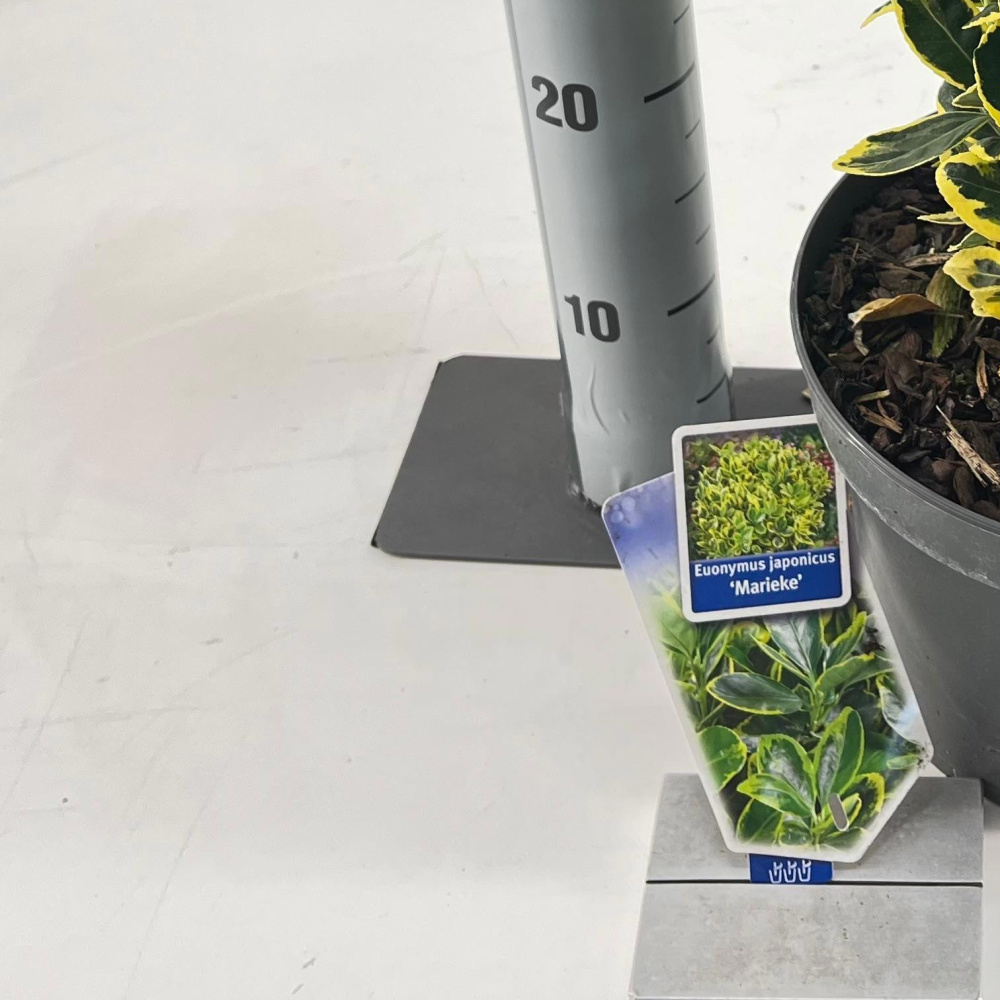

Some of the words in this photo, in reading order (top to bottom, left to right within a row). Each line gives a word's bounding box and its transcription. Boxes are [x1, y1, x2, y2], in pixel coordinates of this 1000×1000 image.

[531, 76, 599, 133] 20
[564, 294, 621, 343] 10
[694, 559, 766, 577] Euonymus
[769, 552, 836, 573] japonicus
